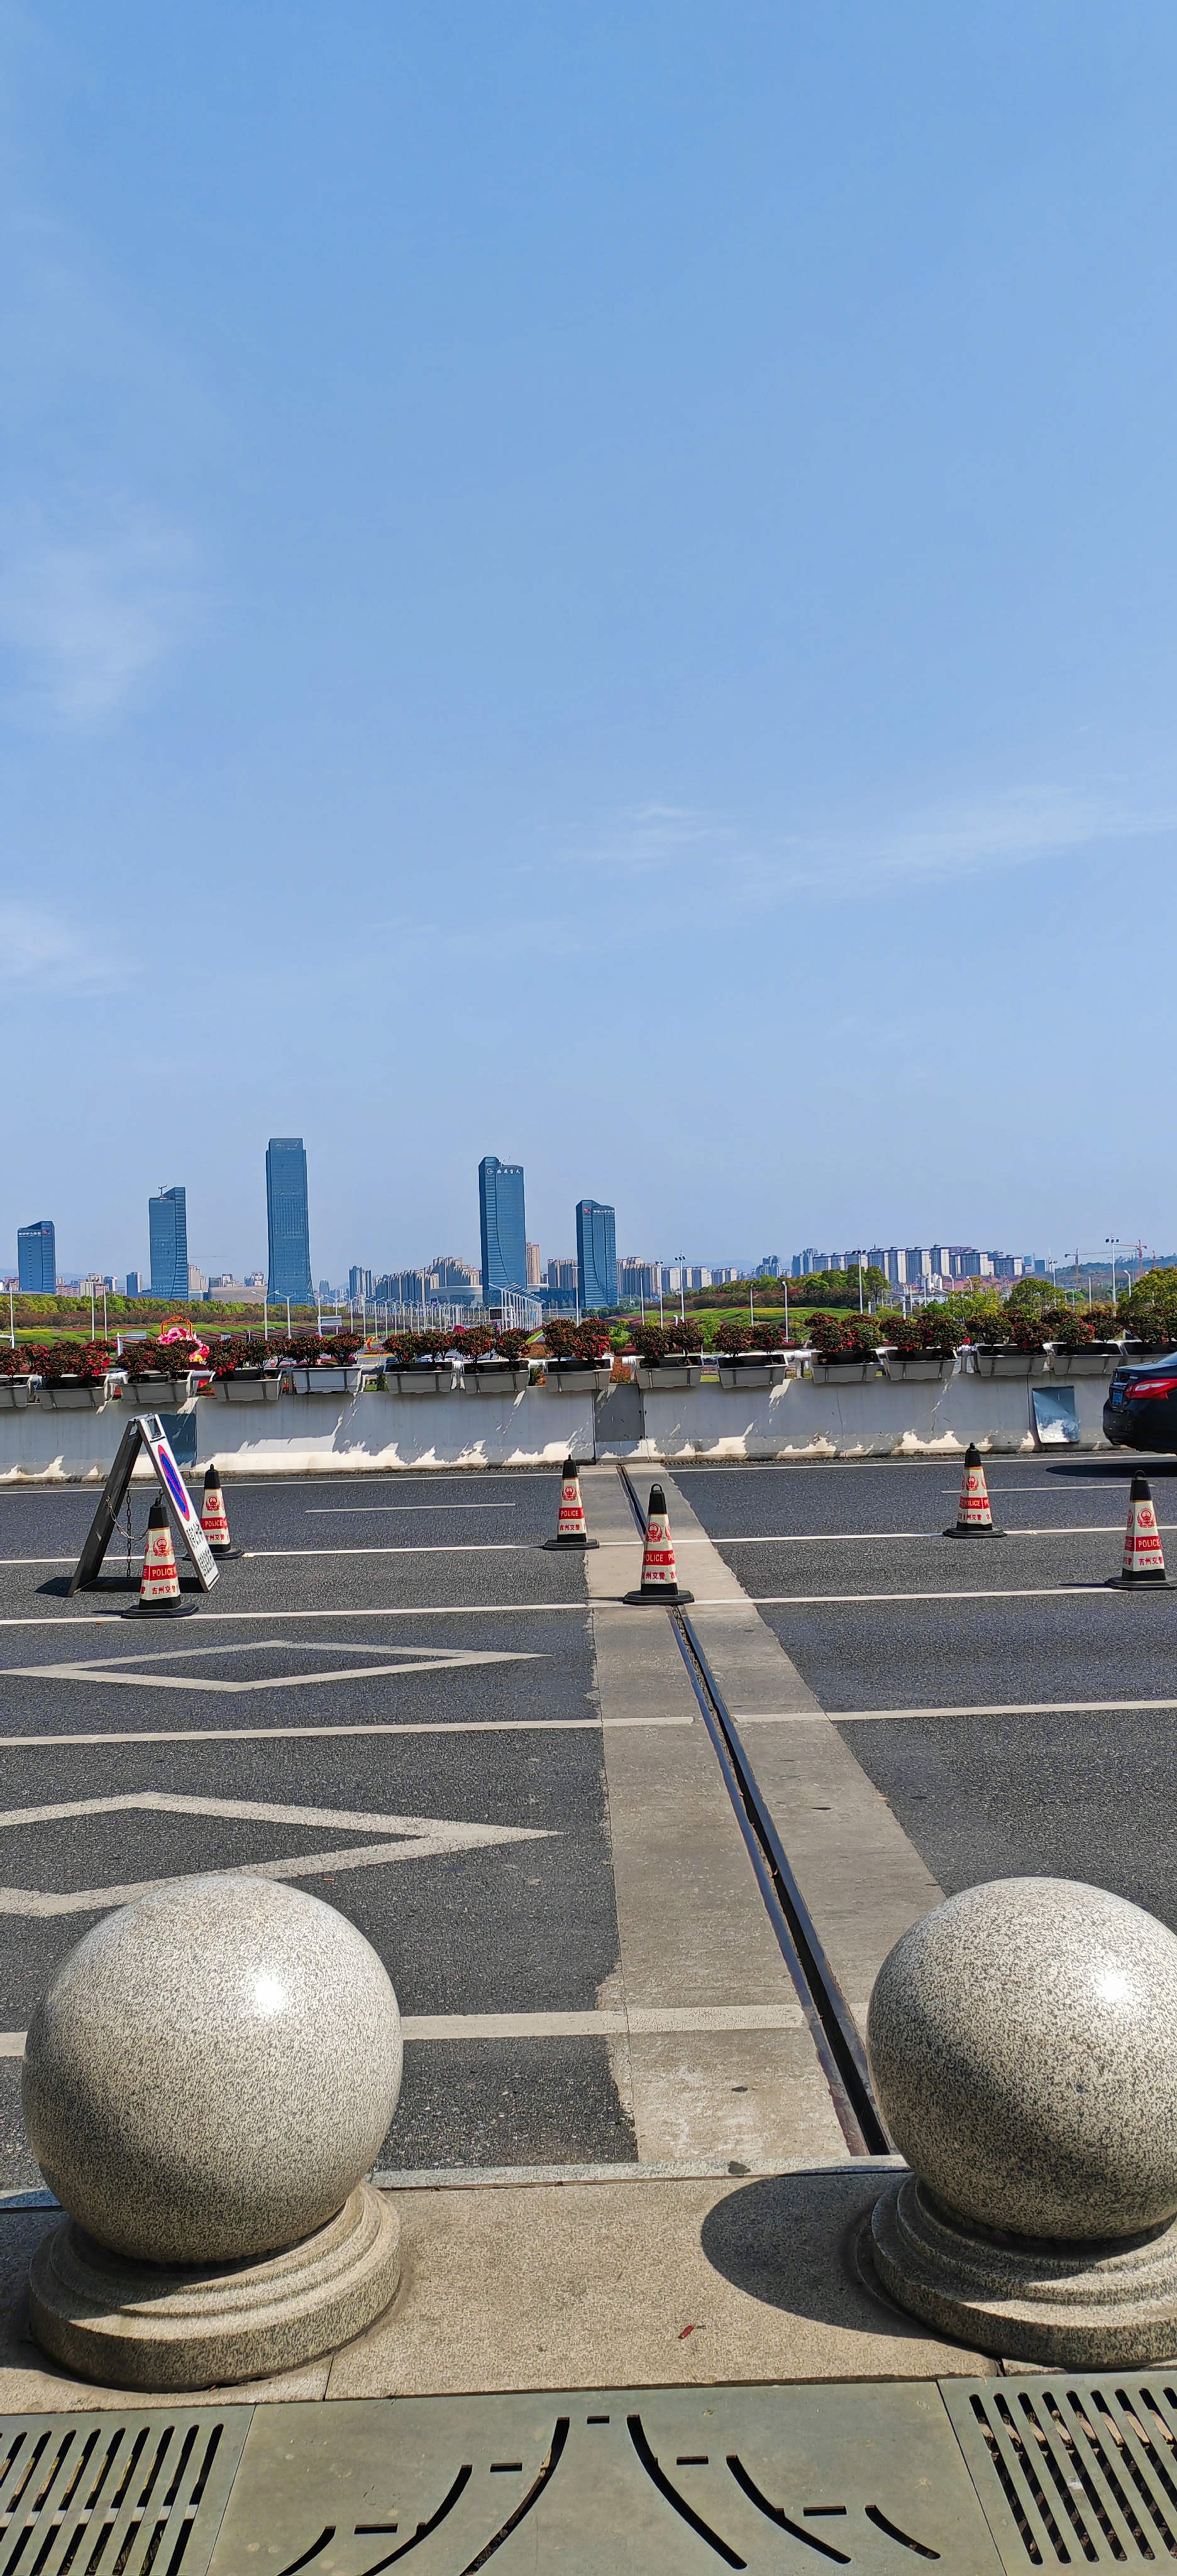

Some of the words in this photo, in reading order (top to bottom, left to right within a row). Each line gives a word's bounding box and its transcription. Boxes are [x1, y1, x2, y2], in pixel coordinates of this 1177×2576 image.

[204, 1519, 223, 1527] POLICE
[1138, 1538, 1161, 1548] POLICE
[644, 1553, 664, 1562] OLICE
[152, 1567, 174, 1577] POLICE
